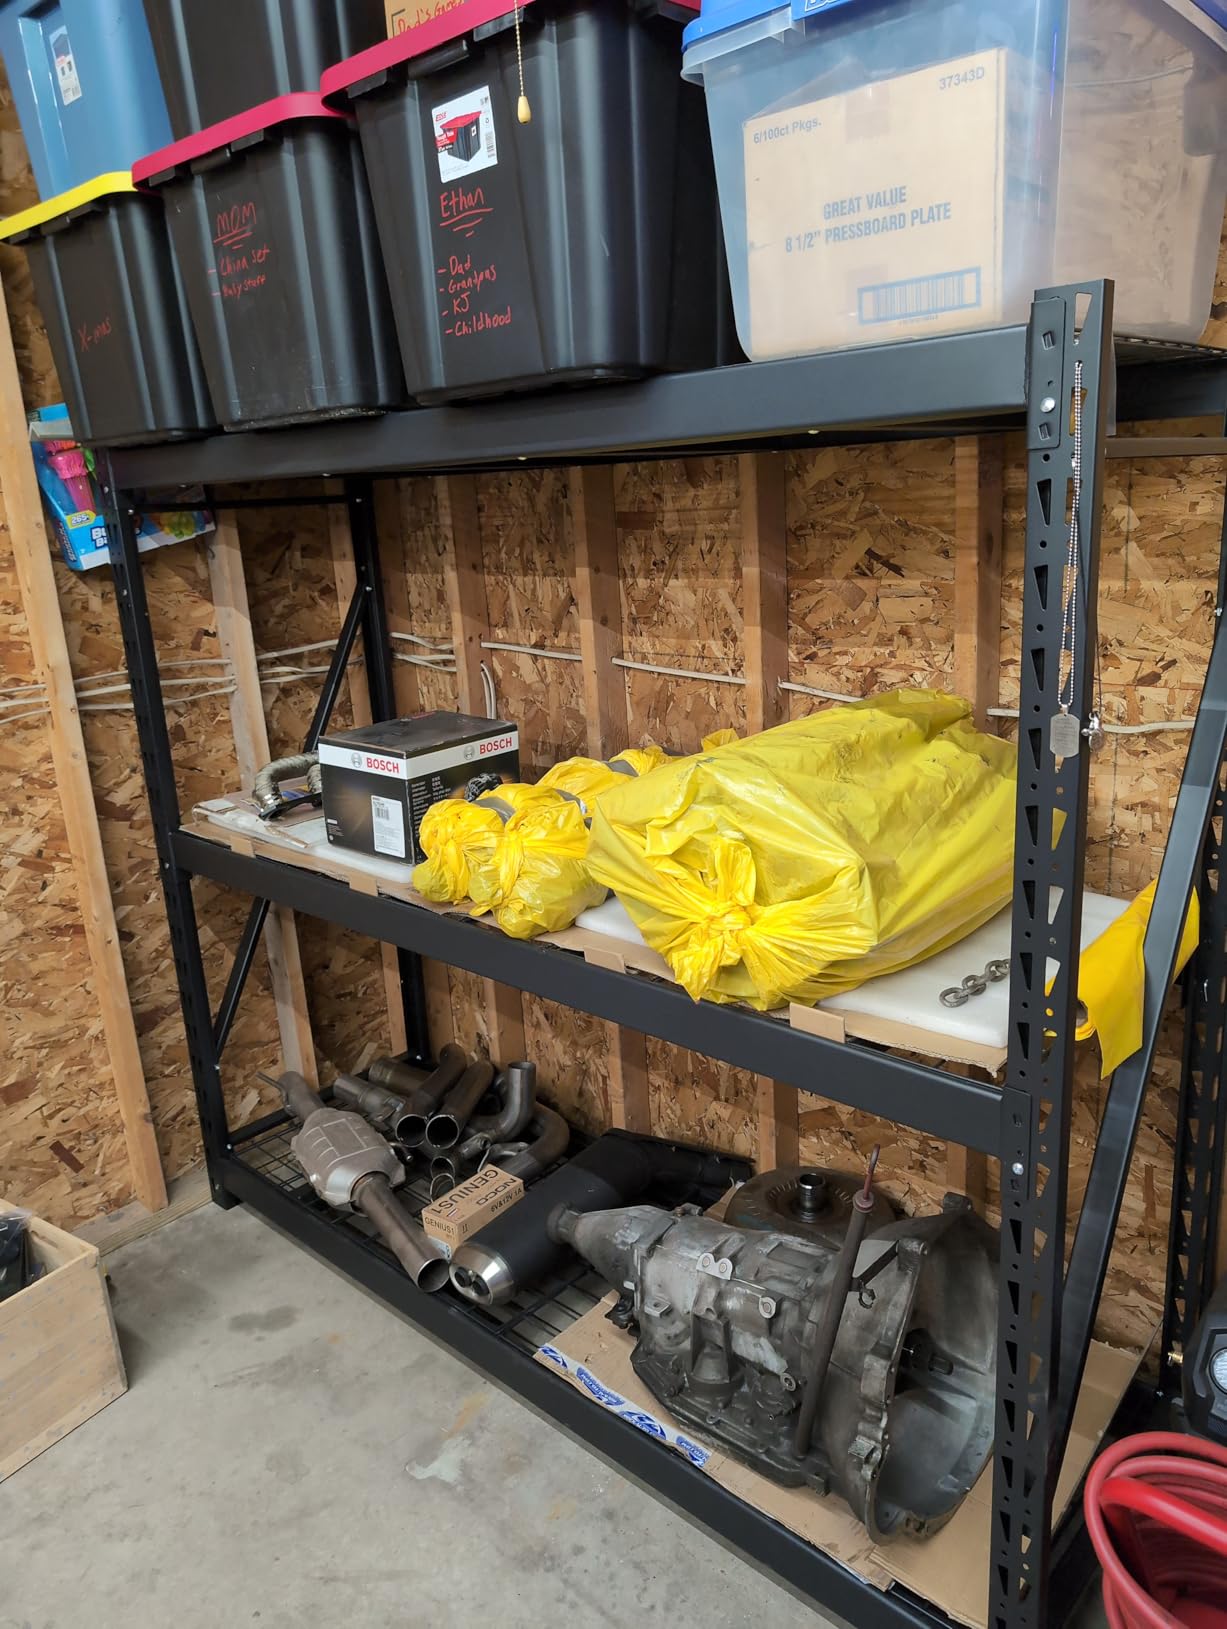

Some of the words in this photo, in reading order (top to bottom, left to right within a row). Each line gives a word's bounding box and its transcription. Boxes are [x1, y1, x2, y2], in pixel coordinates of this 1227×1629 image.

[938, 67, 986, 90] 37343D
[753, 125, 790, 145] 6/100ct
[792, 116, 822, 135] Pkgs.
[439, 187, 485, 217] Ethan
[823, 197, 862, 220] GREAT
[866, 186, 907, 210] VALUE
[217, 202, 257, 237] MOM
[785, 236, 793, 253] 8
[825, 212, 907, 245] PRESSBOARD
[911, 202, 952, 228] PLATE
[479, 737, 513, 755] BOSCH
[366, 757, 400, 774] BOSCH
[431, 1169, 498, 1214] GENIUS1
[477, 1178, 517, 1206] NOCO
[424, 1216, 455, 1235] GENIUS1
